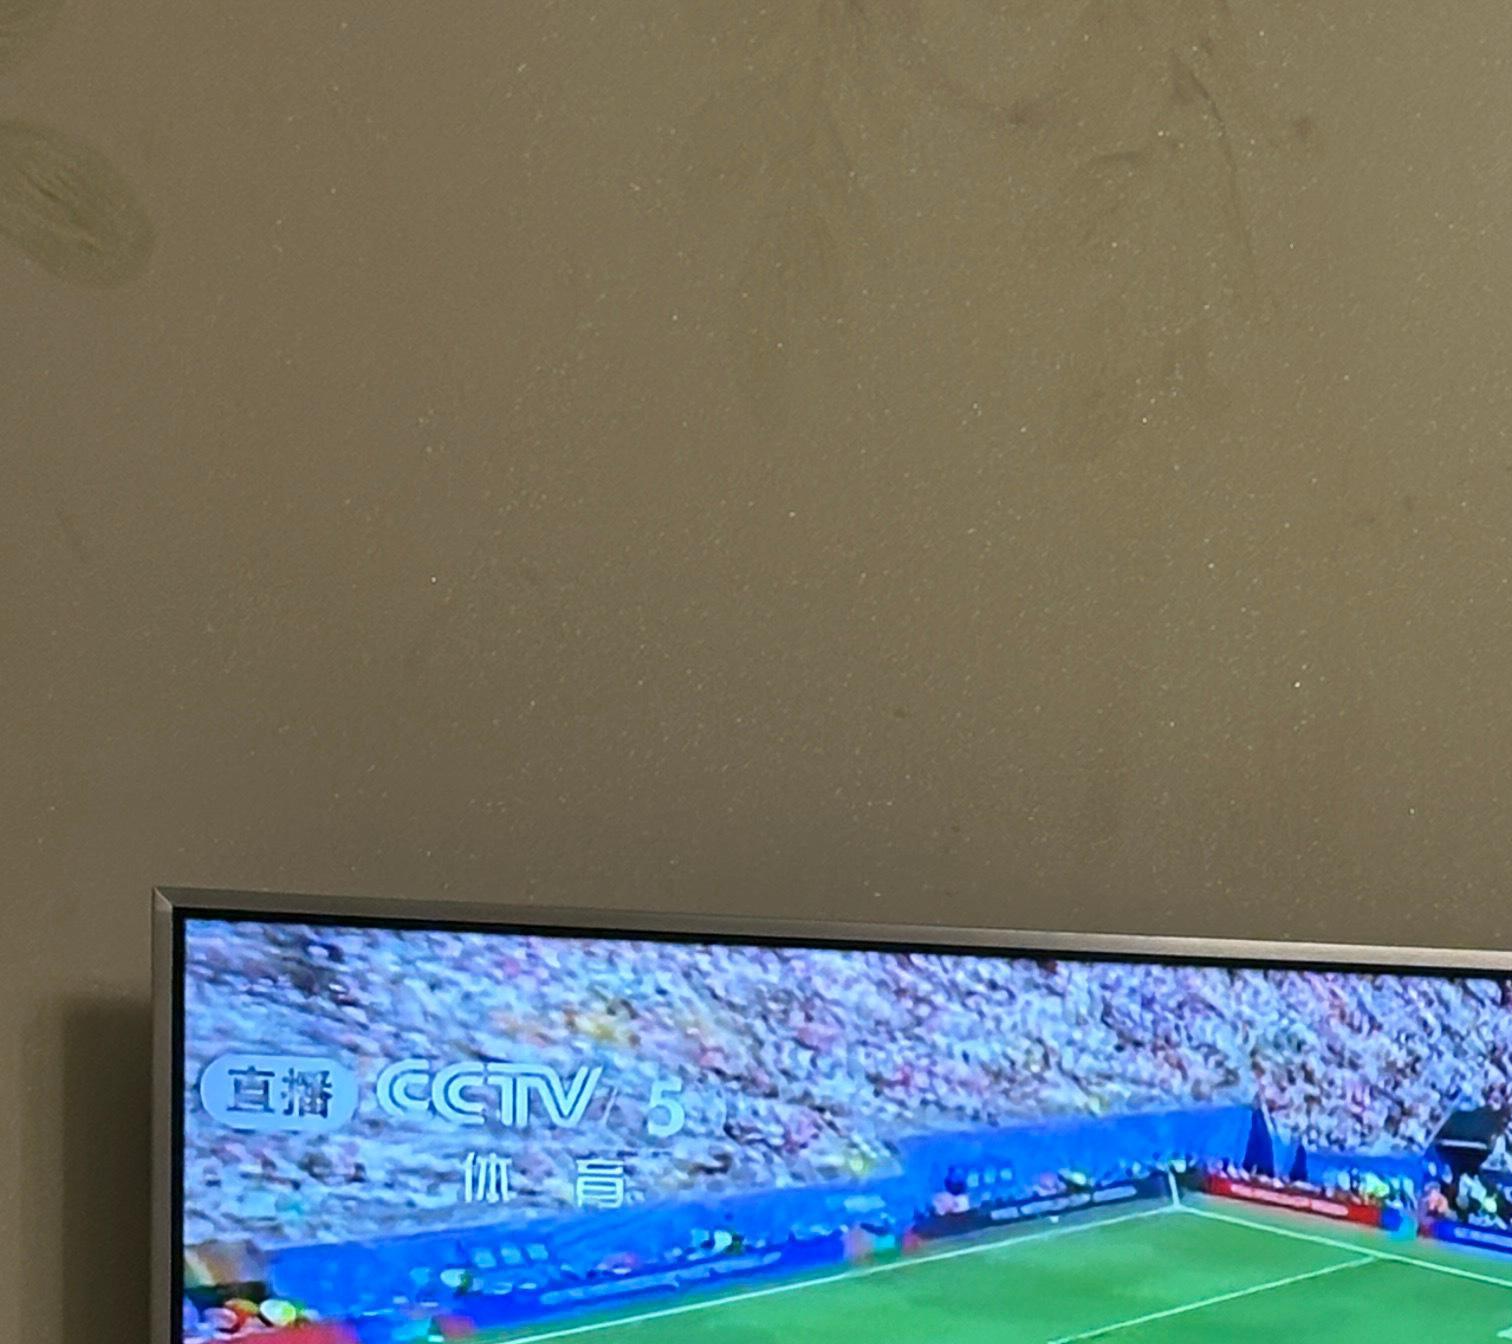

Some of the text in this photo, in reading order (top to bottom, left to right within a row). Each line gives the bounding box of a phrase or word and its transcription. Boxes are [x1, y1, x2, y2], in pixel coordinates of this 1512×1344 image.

[226, 1065, 334, 1119] 直播
[376, 1058, 686, 1137] CCTV 5
[465, 1152, 625, 1209] 体育
